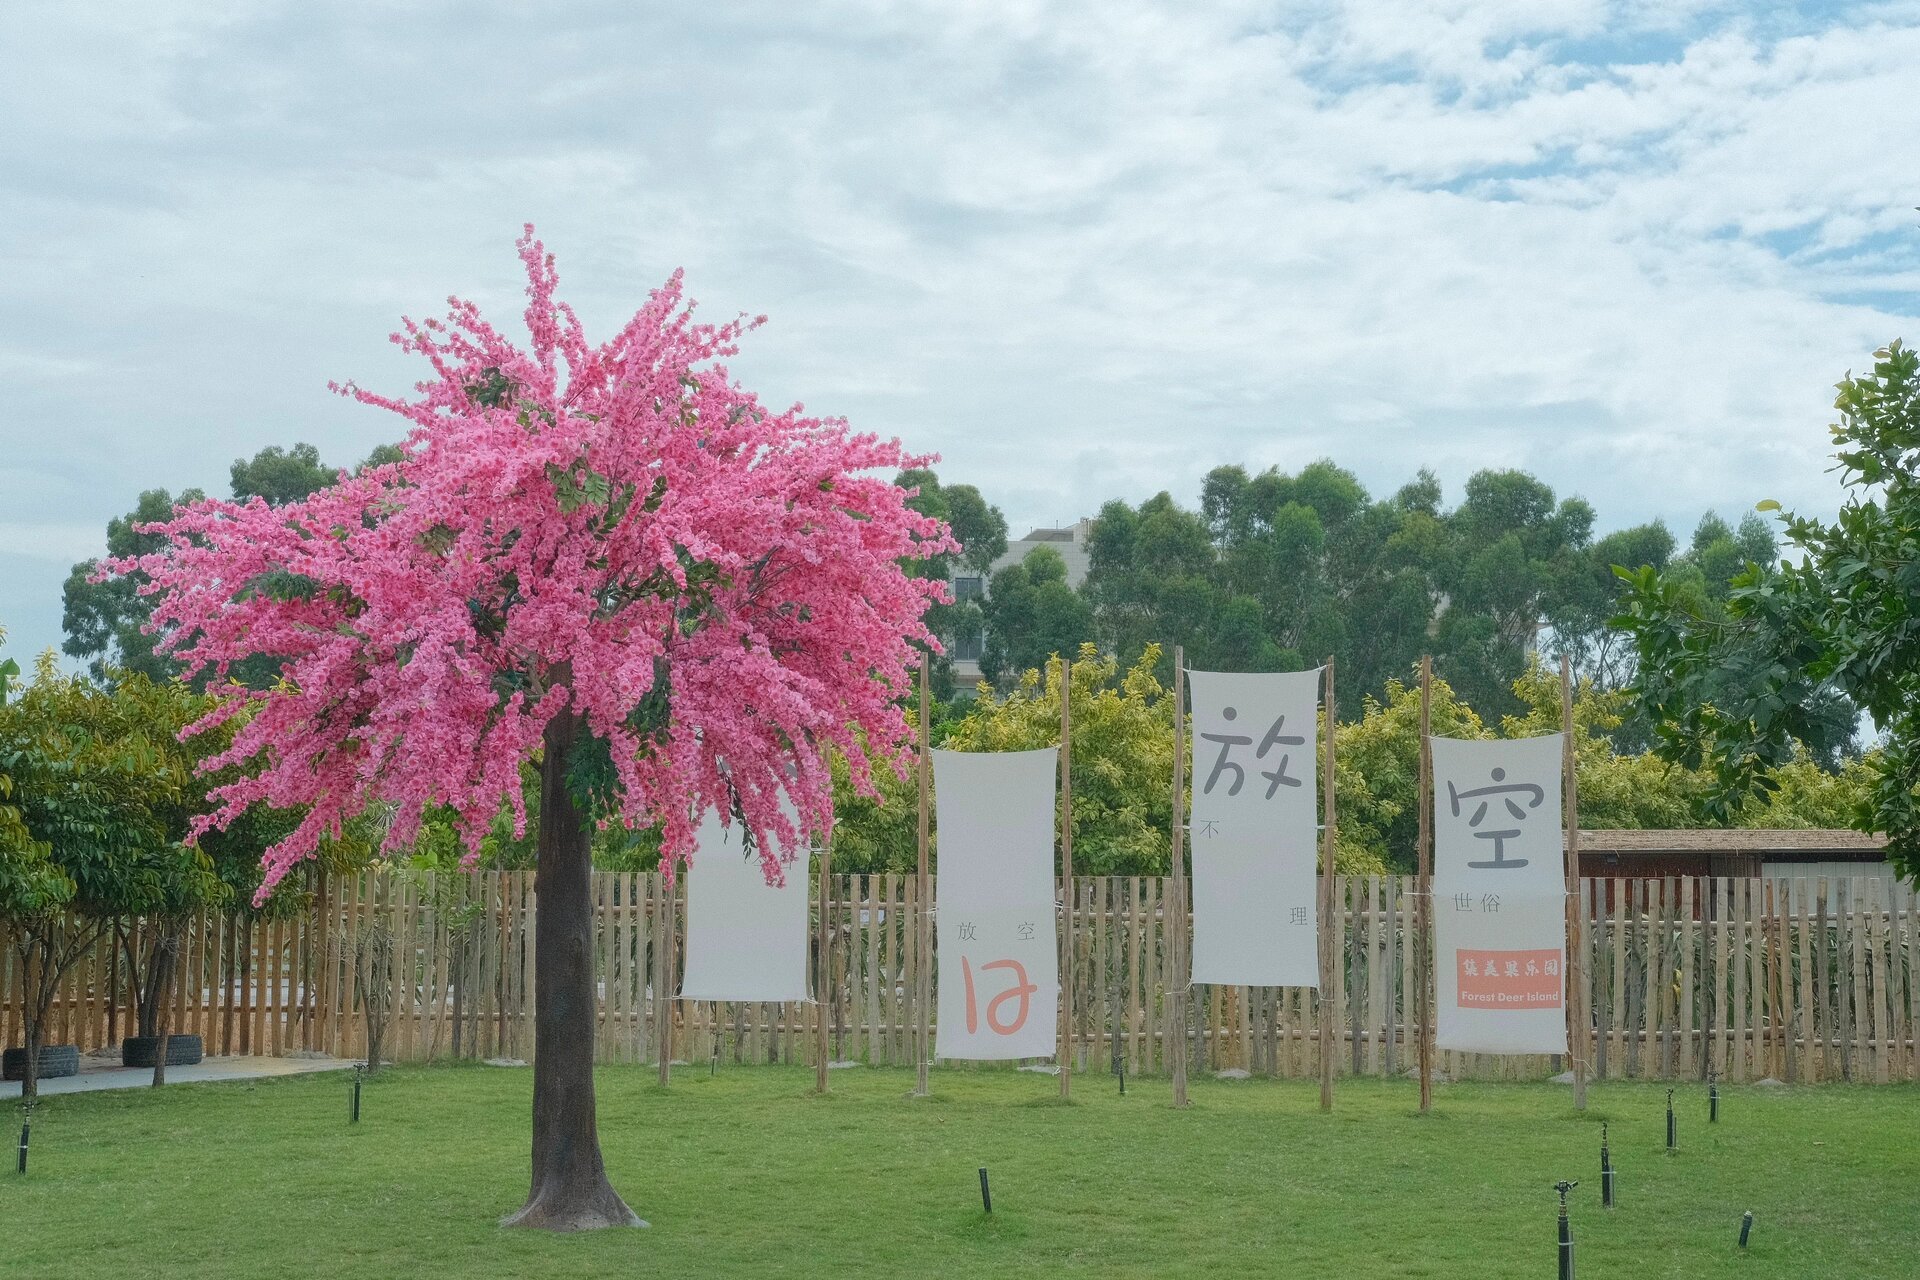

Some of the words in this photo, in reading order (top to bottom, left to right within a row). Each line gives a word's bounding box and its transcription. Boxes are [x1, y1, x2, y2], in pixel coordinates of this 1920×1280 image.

[1200, 706, 1305, 800] 放
[1447, 767, 1544, 869] 空
[1200, 819, 1220, 839] 不
[1289, 906, 1308, 926] 理
[957, 921, 977, 941] 放
[1016, 921, 1035, 941] 空
[1462, 991, 1496, 1002] Forest
[1498, 992, 1525, 1002] Deer
[1527, 991, 1559, 1002] Island
